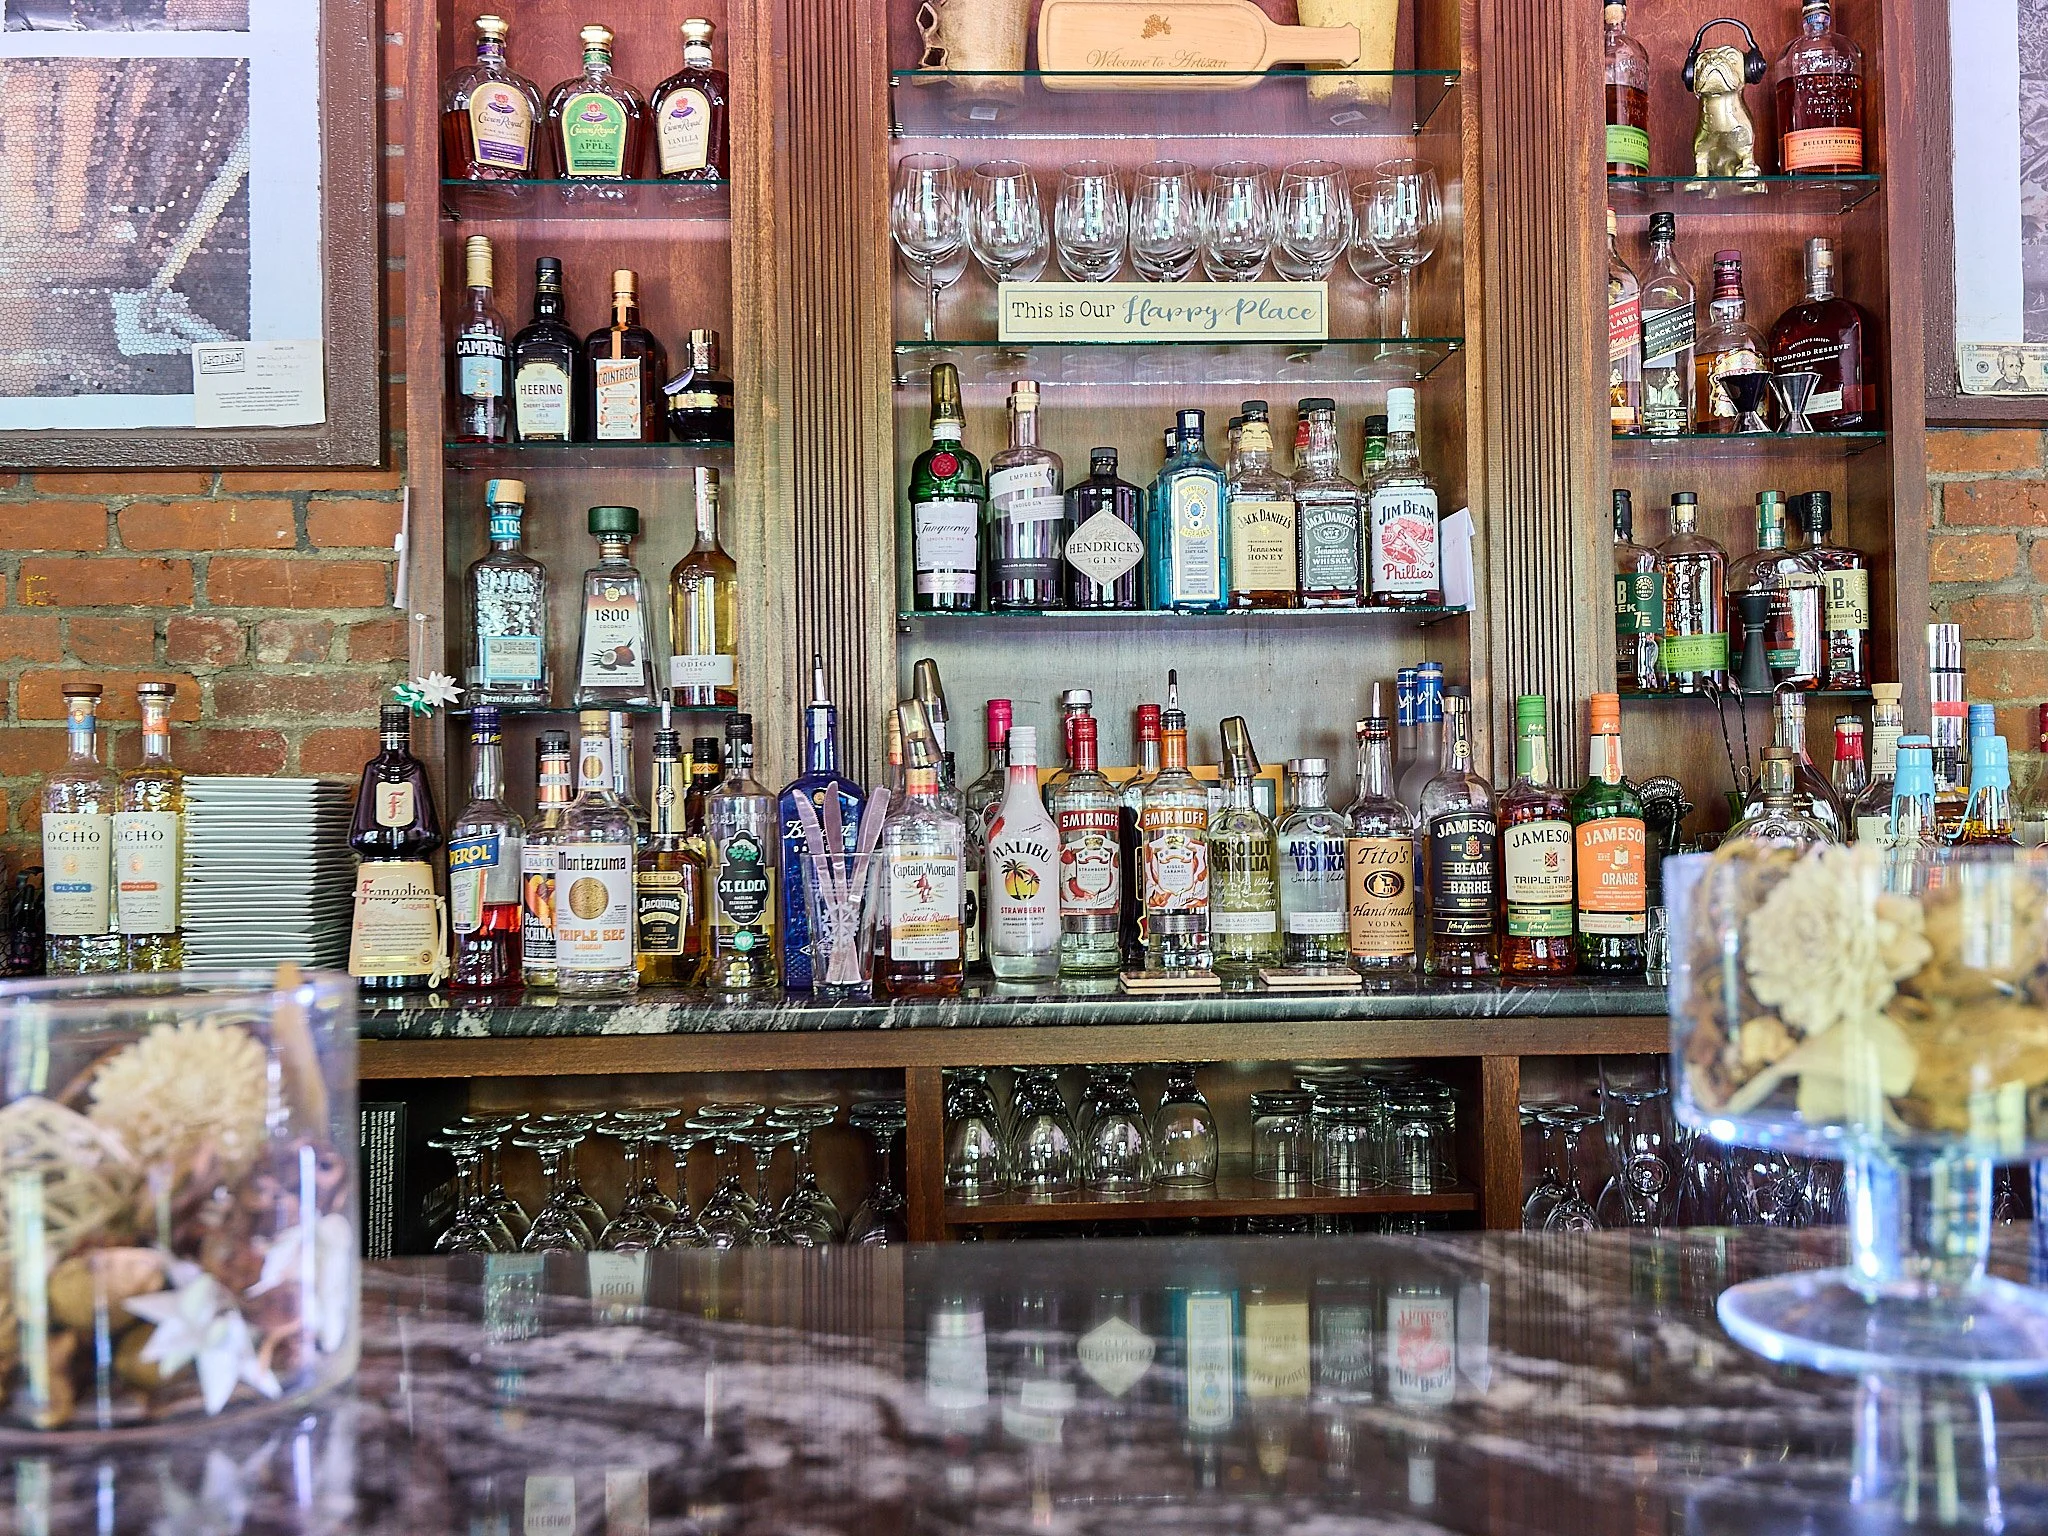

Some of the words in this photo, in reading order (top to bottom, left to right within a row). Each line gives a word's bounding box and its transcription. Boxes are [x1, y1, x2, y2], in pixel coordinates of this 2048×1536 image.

[1087, 48, 1150, 68] Welcome
[1150, 56, 1165, 67] to
[1169, 49, 1228, 68] Artisan
[478, 112, 502, 124] Crown
[500, 117, 524, 129] Royal
[664, 120, 683, 134] Crown
[680, 116, 703, 131] Royal
[570, 124, 594, 137] Crown
[592, 124, 618, 137] Royal
[578, 142, 611, 150] APPLE
[668, 134, 698, 145] VANILLA
[1012, 301, 1054, 320] This
[1058, 301, 1074, 318] is
[1080, 300, 1116, 318] Our
[1122, 295, 1224, 329] Happy
[1225, 298, 1317, 325] Place
[1610, 314, 1639, 329] LABEL
[1648, 321, 1671, 332] JOHNNIE
[1671, 312, 1693, 322] WALKER
[1644, 327, 1671, 342] BLACK
[1673, 319, 1696, 331] LABEL
[457, 341, 506, 357] CAMPARI
[1773, 350, 1811, 362] WOODFORD
[1813, 344, 1850, 355] RESERVE
[202, 352, 242, 365] ARTISAN
[598, 367, 639, 386] COINTREAU
[520, 384, 562, 395] HEERING
[1665, 410, 1676, 418] 12
[1009, 471, 1042, 481] EMPRESS
[1238, 512, 1258, 529] JACK
[1260, 509, 1292, 529] DANIEL'S
[1305, 513, 1325, 530] JACK
[1325, 510, 1358, 530] DANIEL'S
[1379, 504, 1400, 525] JIM
[1403, 500, 1434, 525] BEAM
[921, 522, 970, 535] Tanqueray
[1070, 541, 1140, 554] HENDRICK'S
[1248, 544, 1283, 552] Tennessee
[1314, 546, 1349, 555] Tennessee
[1383, 563, 1434, 579] Phillies
[595, 608, 630, 621] 1800
[52, 820, 93, 830] TEQUILA
[1063, 811, 1119, 827] SMIRNOFF
[1146, 810, 1204, 826] SMIRNOFF
[118, 830, 164, 842] OCHO
[1437, 819, 1496, 838] JAMESON
[48, 832, 100, 842] OCHO
[1512, 830, 1571, 848] JAMESO
[992, 841, 1053, 863] MALIBU
[1212, 841, 1272, 856] ABSOLUT
[1290, 841, 1344, 856] ABSOLU
[1358, 845, 1408, 864] Tito's
[559, 852, 626, 870] Montezuma
[1213, 856, 1269, 872] VANILIA
[1294, 857, 1345, 872] VODKA
[1454, 862, 1489, 875] BLACK
[893, 863, 924, 878] Captain
[926, 862, 956, 878] Morgan
[720, 880, 733, 892] ST.
[734, 880, 766, 892] ELDER
[1514, 876, 1550, 884] TRIPLE
[1553, 876, 1572, 884] TRIP
[1602, 873, 1638, 885] ORANGE
[361, 879, 430, 904] Frangelico
[1450, 881, 1491, 894] BARREL
[639, 898, 680, 912] JACQUIN'S
[1353, 902, 1413, 916] Handmade
[900, 913, 928, 922] Spiced
[930, 912, 950, 922] Rum
[560, 929, 598, 941] TRIPLE
[603, 928, 625, 941] SEC
